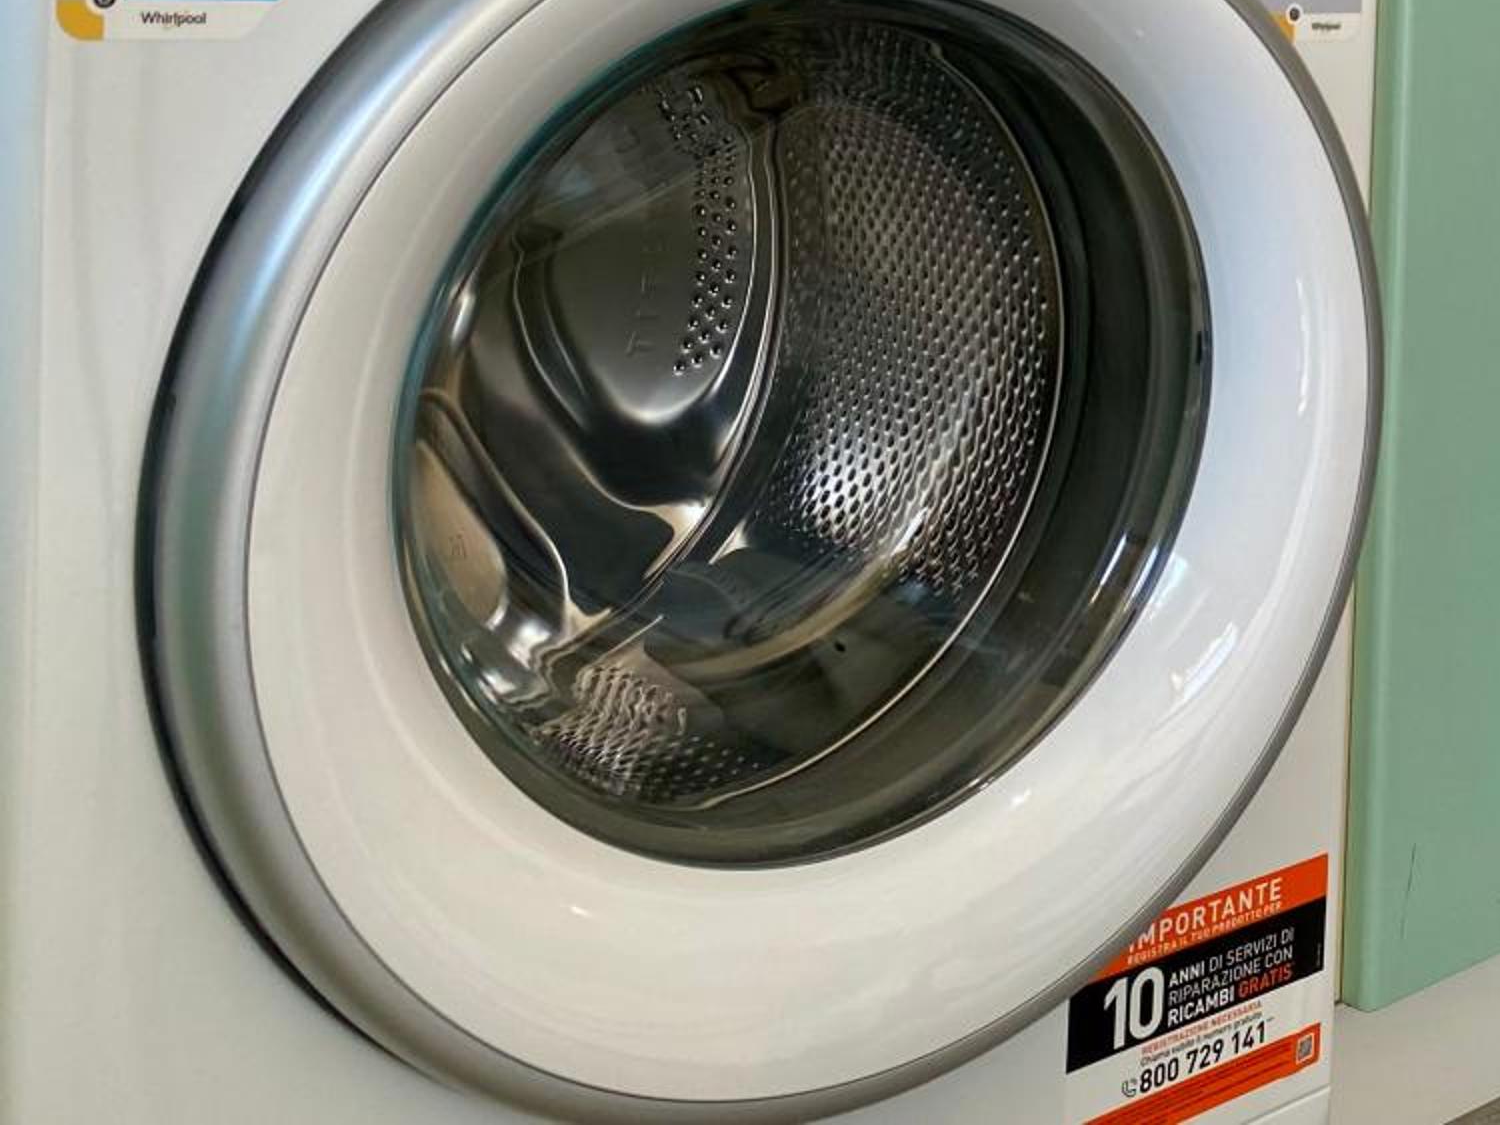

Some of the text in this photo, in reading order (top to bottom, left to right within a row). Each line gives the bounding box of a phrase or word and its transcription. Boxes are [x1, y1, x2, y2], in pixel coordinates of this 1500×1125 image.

[140, 10, 207, 27] Whirlpool
[1168, 927, 1295, 988] ANNI DI SERVIZI DI
[1168, 957, 1261, 1006] RIPARAZIONE
[1264, 944, 1294, 969] CON
[1103, 966, 1166, 1051] 10
[1167, 987, 1235, 1029] RICAMBI
[1139, 1056, 1180, 1094] 800
[1186, 1039, 1224, 1074] 729
[1230, 1019, 1266, 1054] 141
